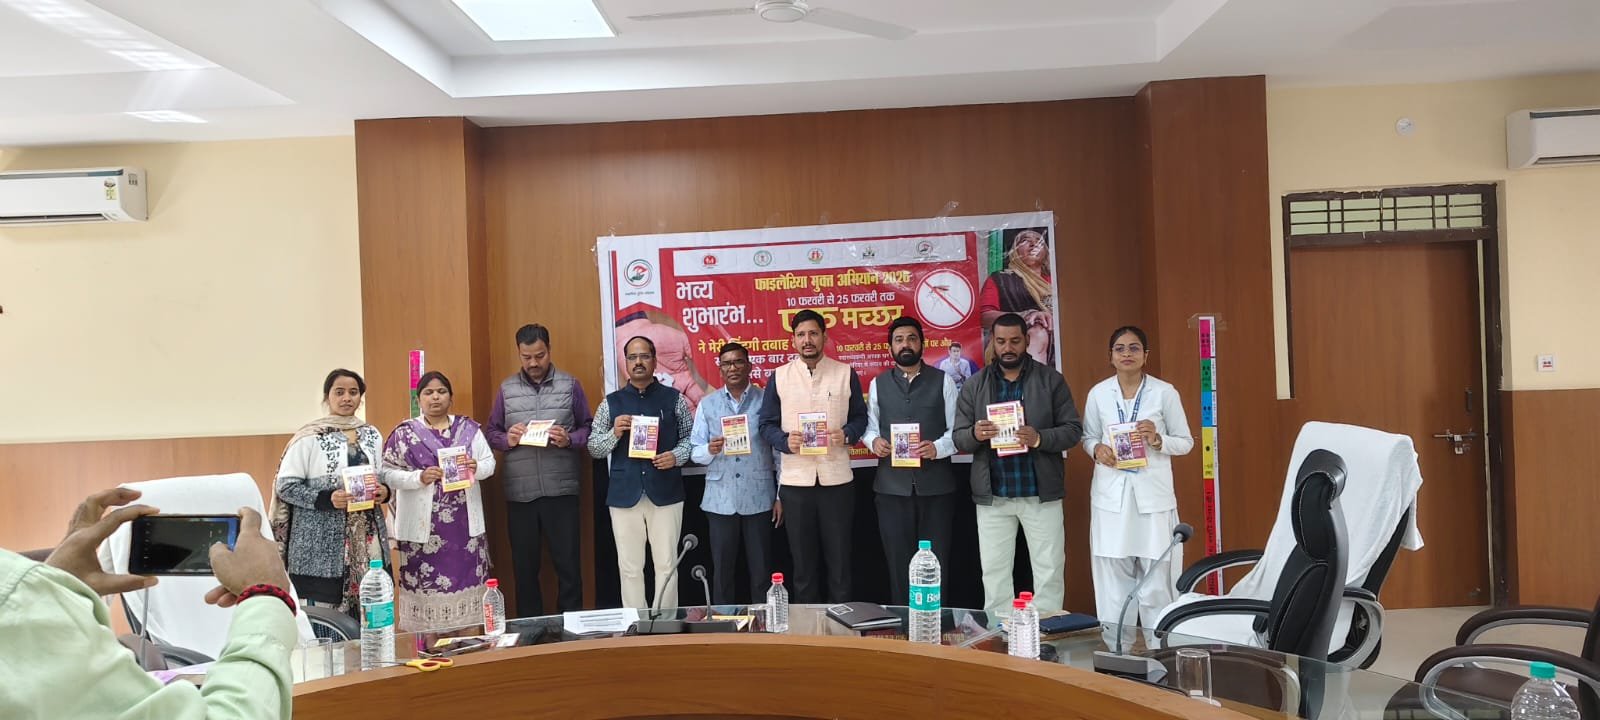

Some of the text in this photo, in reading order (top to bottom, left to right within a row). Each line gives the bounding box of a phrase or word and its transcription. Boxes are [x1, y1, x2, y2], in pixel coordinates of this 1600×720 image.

[755, 268, 911, 292] फाइलेरिया मुक्त अभियान 2026
[676, 280, 713, 300] भव्य
[787, 290, 896, 307] 10 फरवरी से 25 फरवरी तक
[840, 305, 904, 329] मच्छर
[698, 340, 706, 354] ने
[761, 339, 789, 352] तबाह
[836, 344, 843, 352] 10
[844, 341, 865, 351] फरवरी
[865, 342, 872, 351] से
[768, 354, 785, 363] बार
